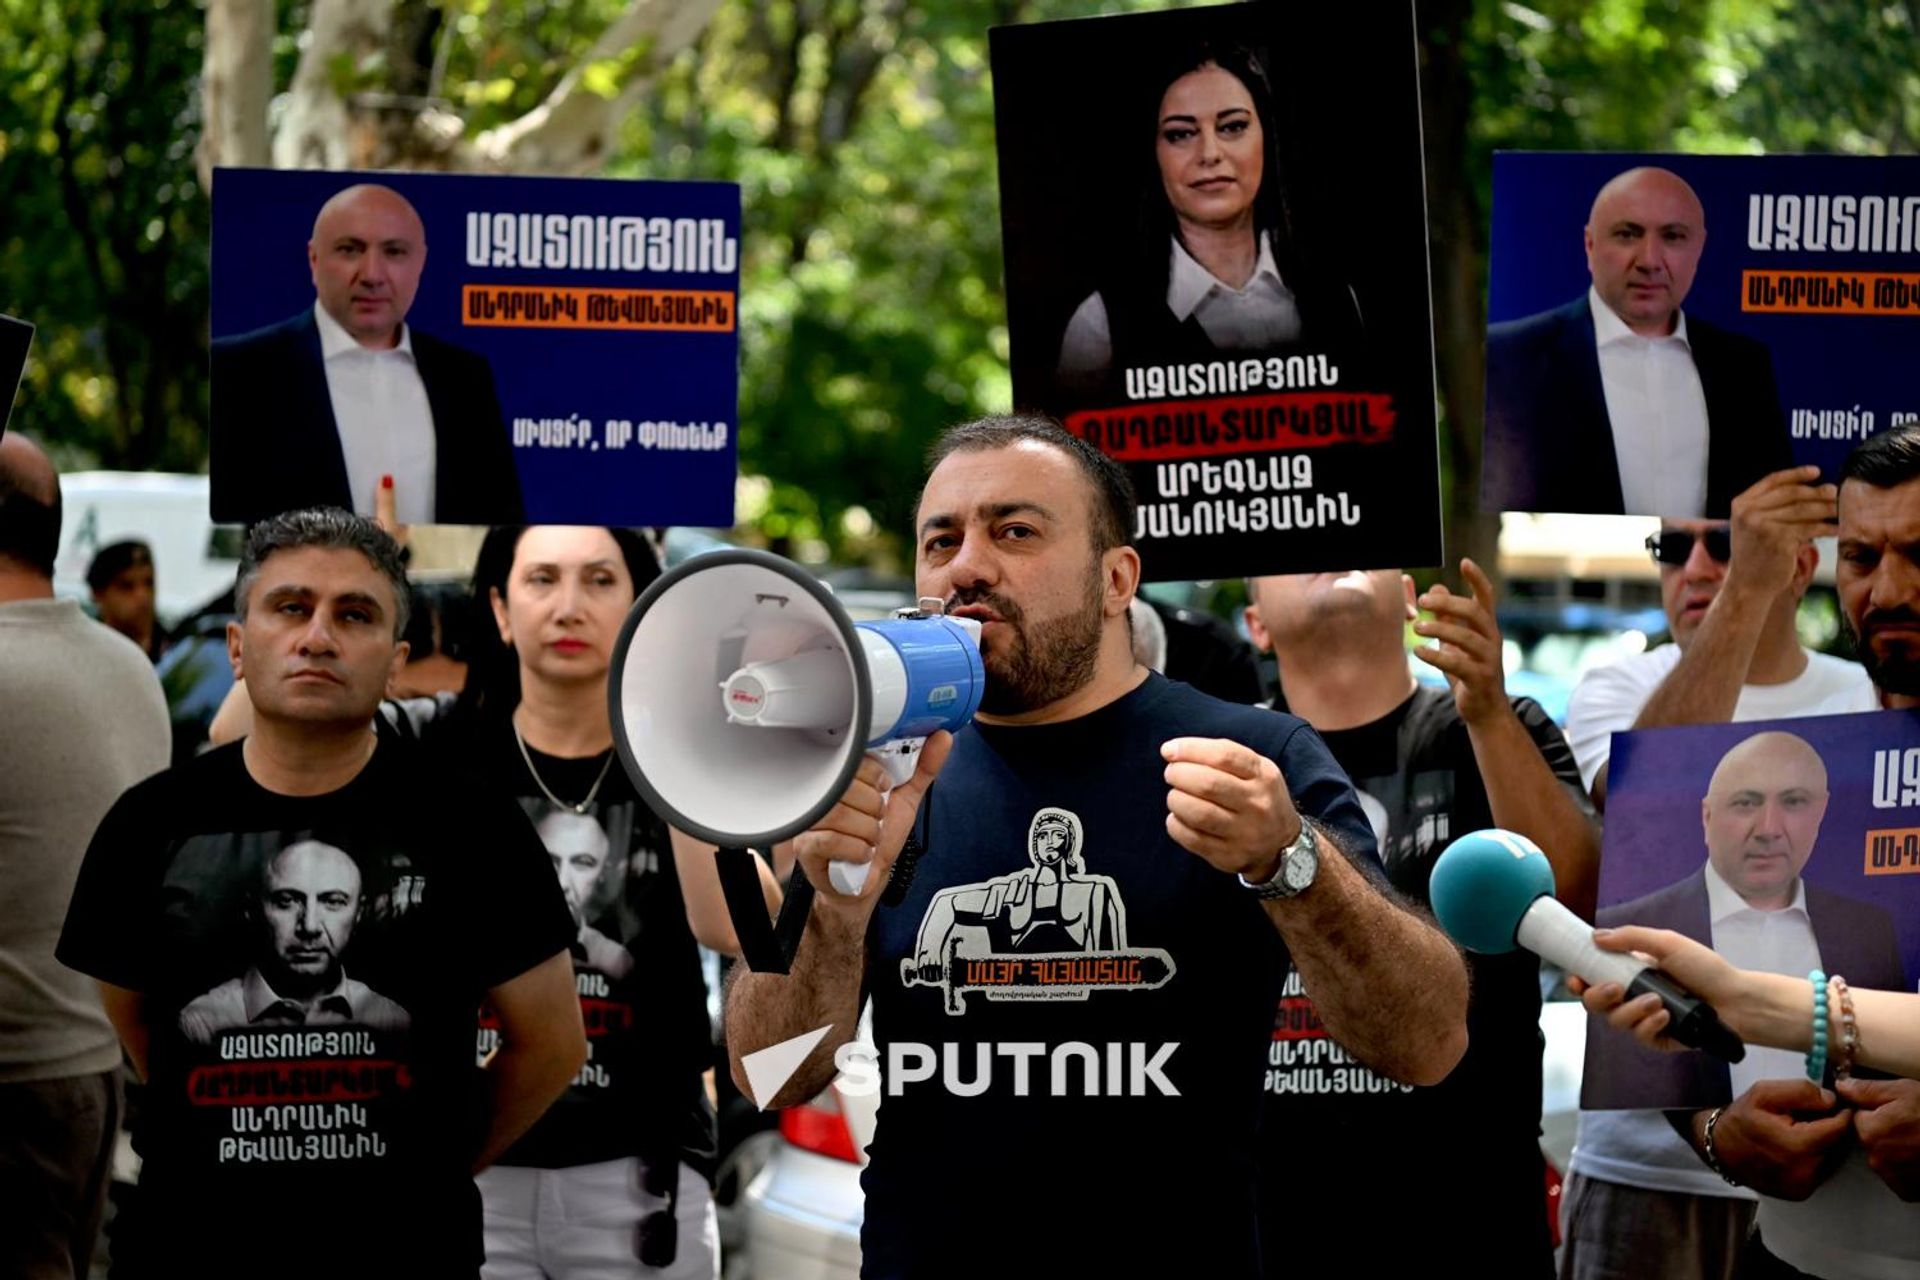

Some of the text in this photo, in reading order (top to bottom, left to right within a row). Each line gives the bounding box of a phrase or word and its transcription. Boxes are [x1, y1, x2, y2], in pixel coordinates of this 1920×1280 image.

[466, 212, 737, 273] ԱԶԱՏՈՒԹՅՈՒՆ
[469, 290, 728, 325] ԱՆԴՐԱՆԻԿ ԹԵՎԱՆՅԱՆԻՆ
[1748, 275, 1865, 308] ԱՆԴՐԱՆԻԿ
[1126, 354, 1338, 399] ԱԶԱՏՈՒԹՅՈՒՆ
[605, 420, 632, 449] ՈՐ
[1157, 454, 1313, 498] ԱՐԵԳՆԱԶ
[966, 961, 1024, 985] ՄԱՅՐ
[220, 1032, 376, 1060] ԱԶԱՏՈՒԹՅՈՒՆ
[231, 1103, 367, 1132] ԱՆԴՐԱՆԻԿ
[219, 1132, 386, 1163] ԹԵՎԱՆՅԱՆԻՆ
